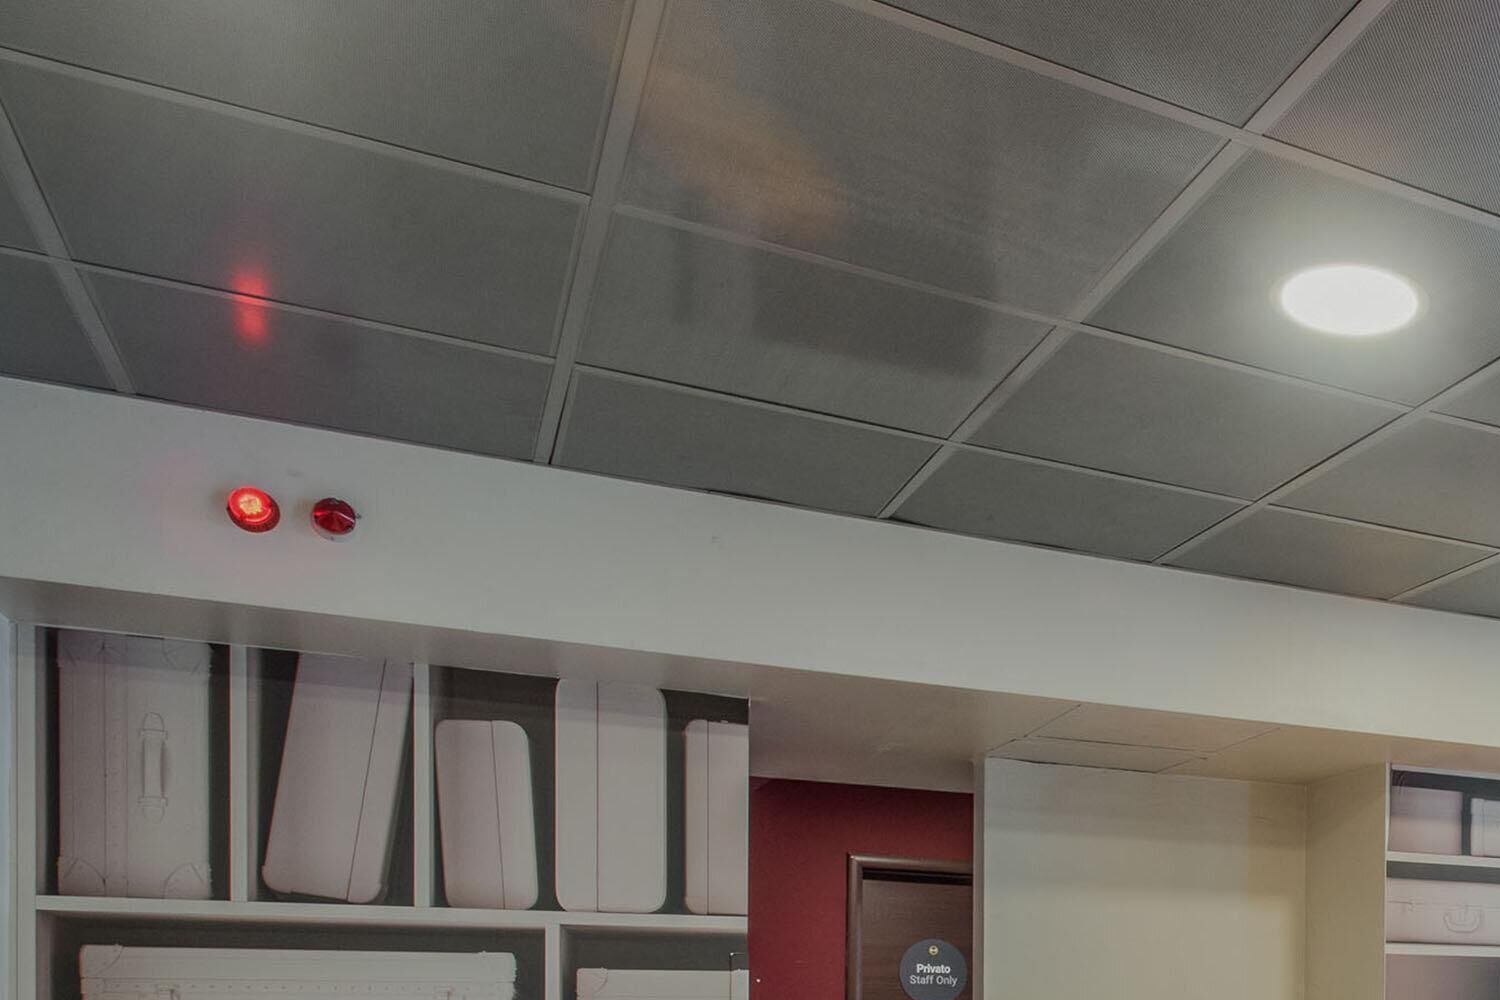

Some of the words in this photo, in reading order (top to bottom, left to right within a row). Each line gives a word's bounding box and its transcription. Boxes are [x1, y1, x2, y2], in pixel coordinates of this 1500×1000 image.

[916, 963, 951, 974] Privato
[909, 975, 934, 985] Staff
[936, 975, 958, 987] Only
